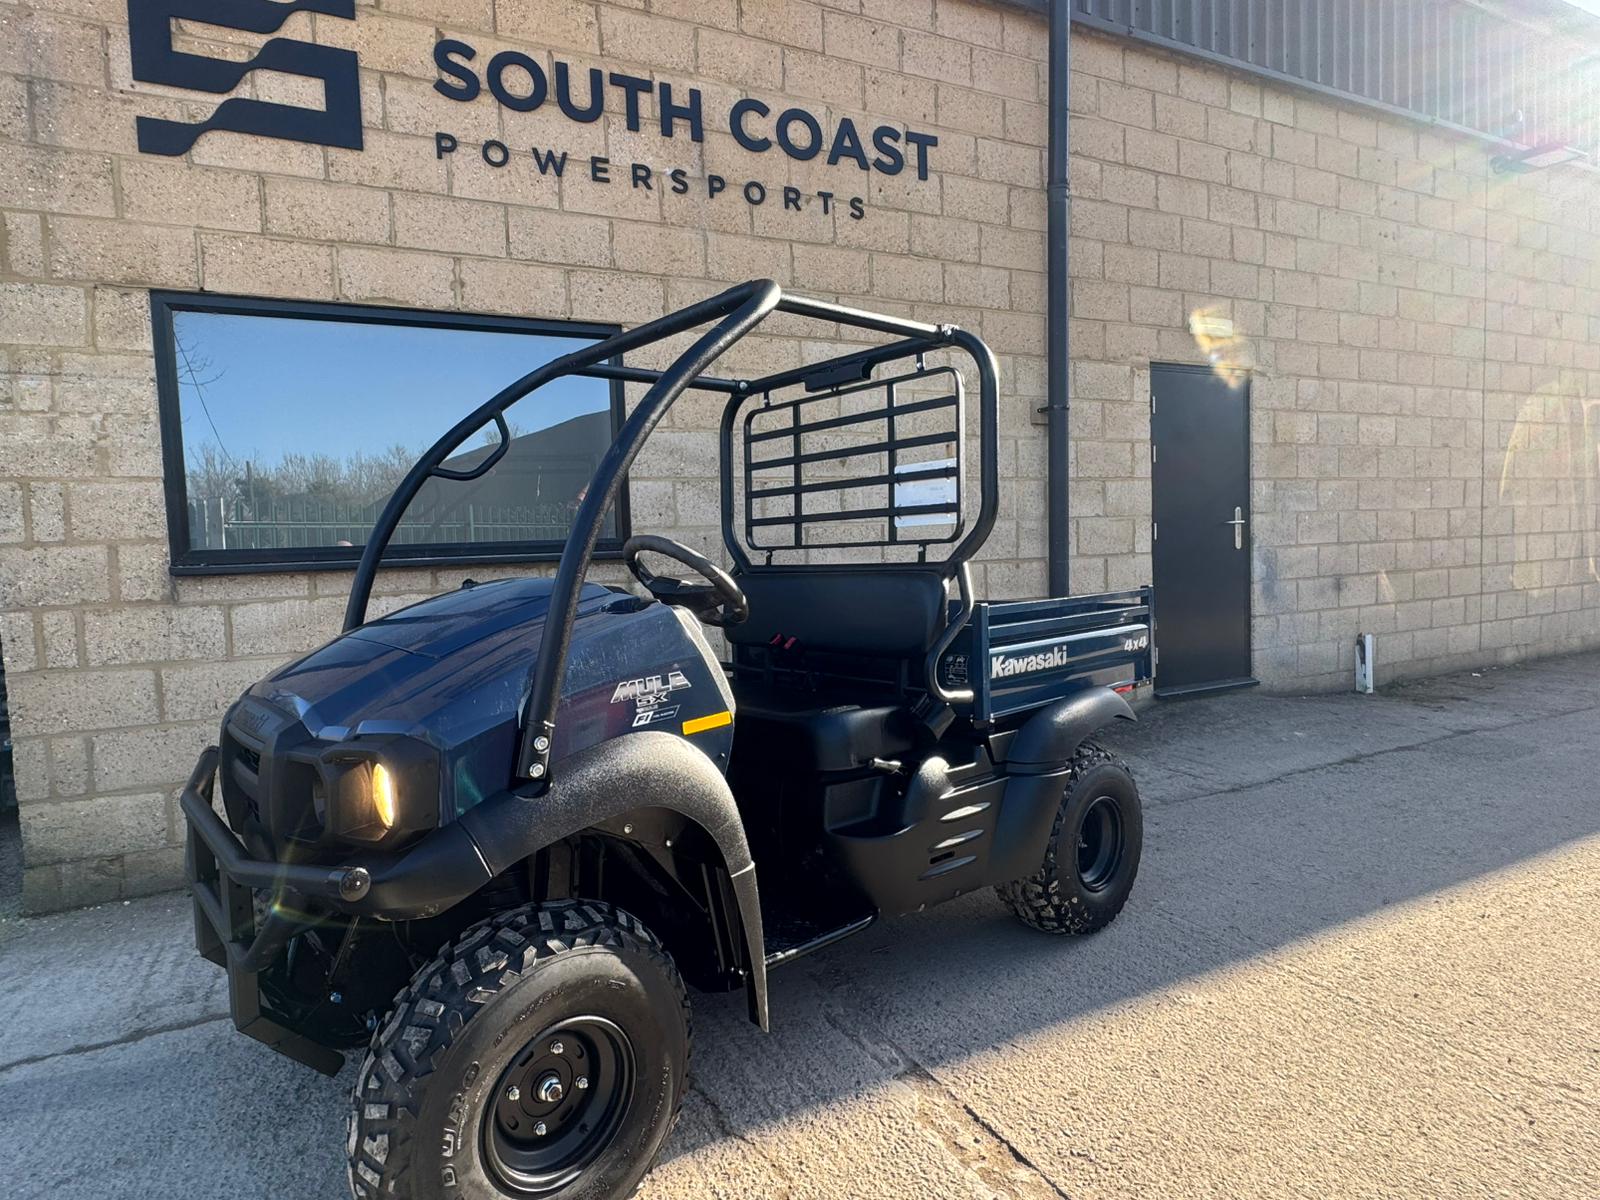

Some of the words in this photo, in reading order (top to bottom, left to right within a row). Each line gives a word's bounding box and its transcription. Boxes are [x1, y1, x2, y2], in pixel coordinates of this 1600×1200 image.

[433, 39, 704, 143] SOUTH
[729, 98, 938, 182] COAST
[436, 132, 865, 220] POWERSPORTS
[1124, 636, 1148, 652] 4x4
[991, 645, 1067, 679] Kawasaki
[610, 671, 692, 703] MULE
[637, 692, 668, 706] SX
